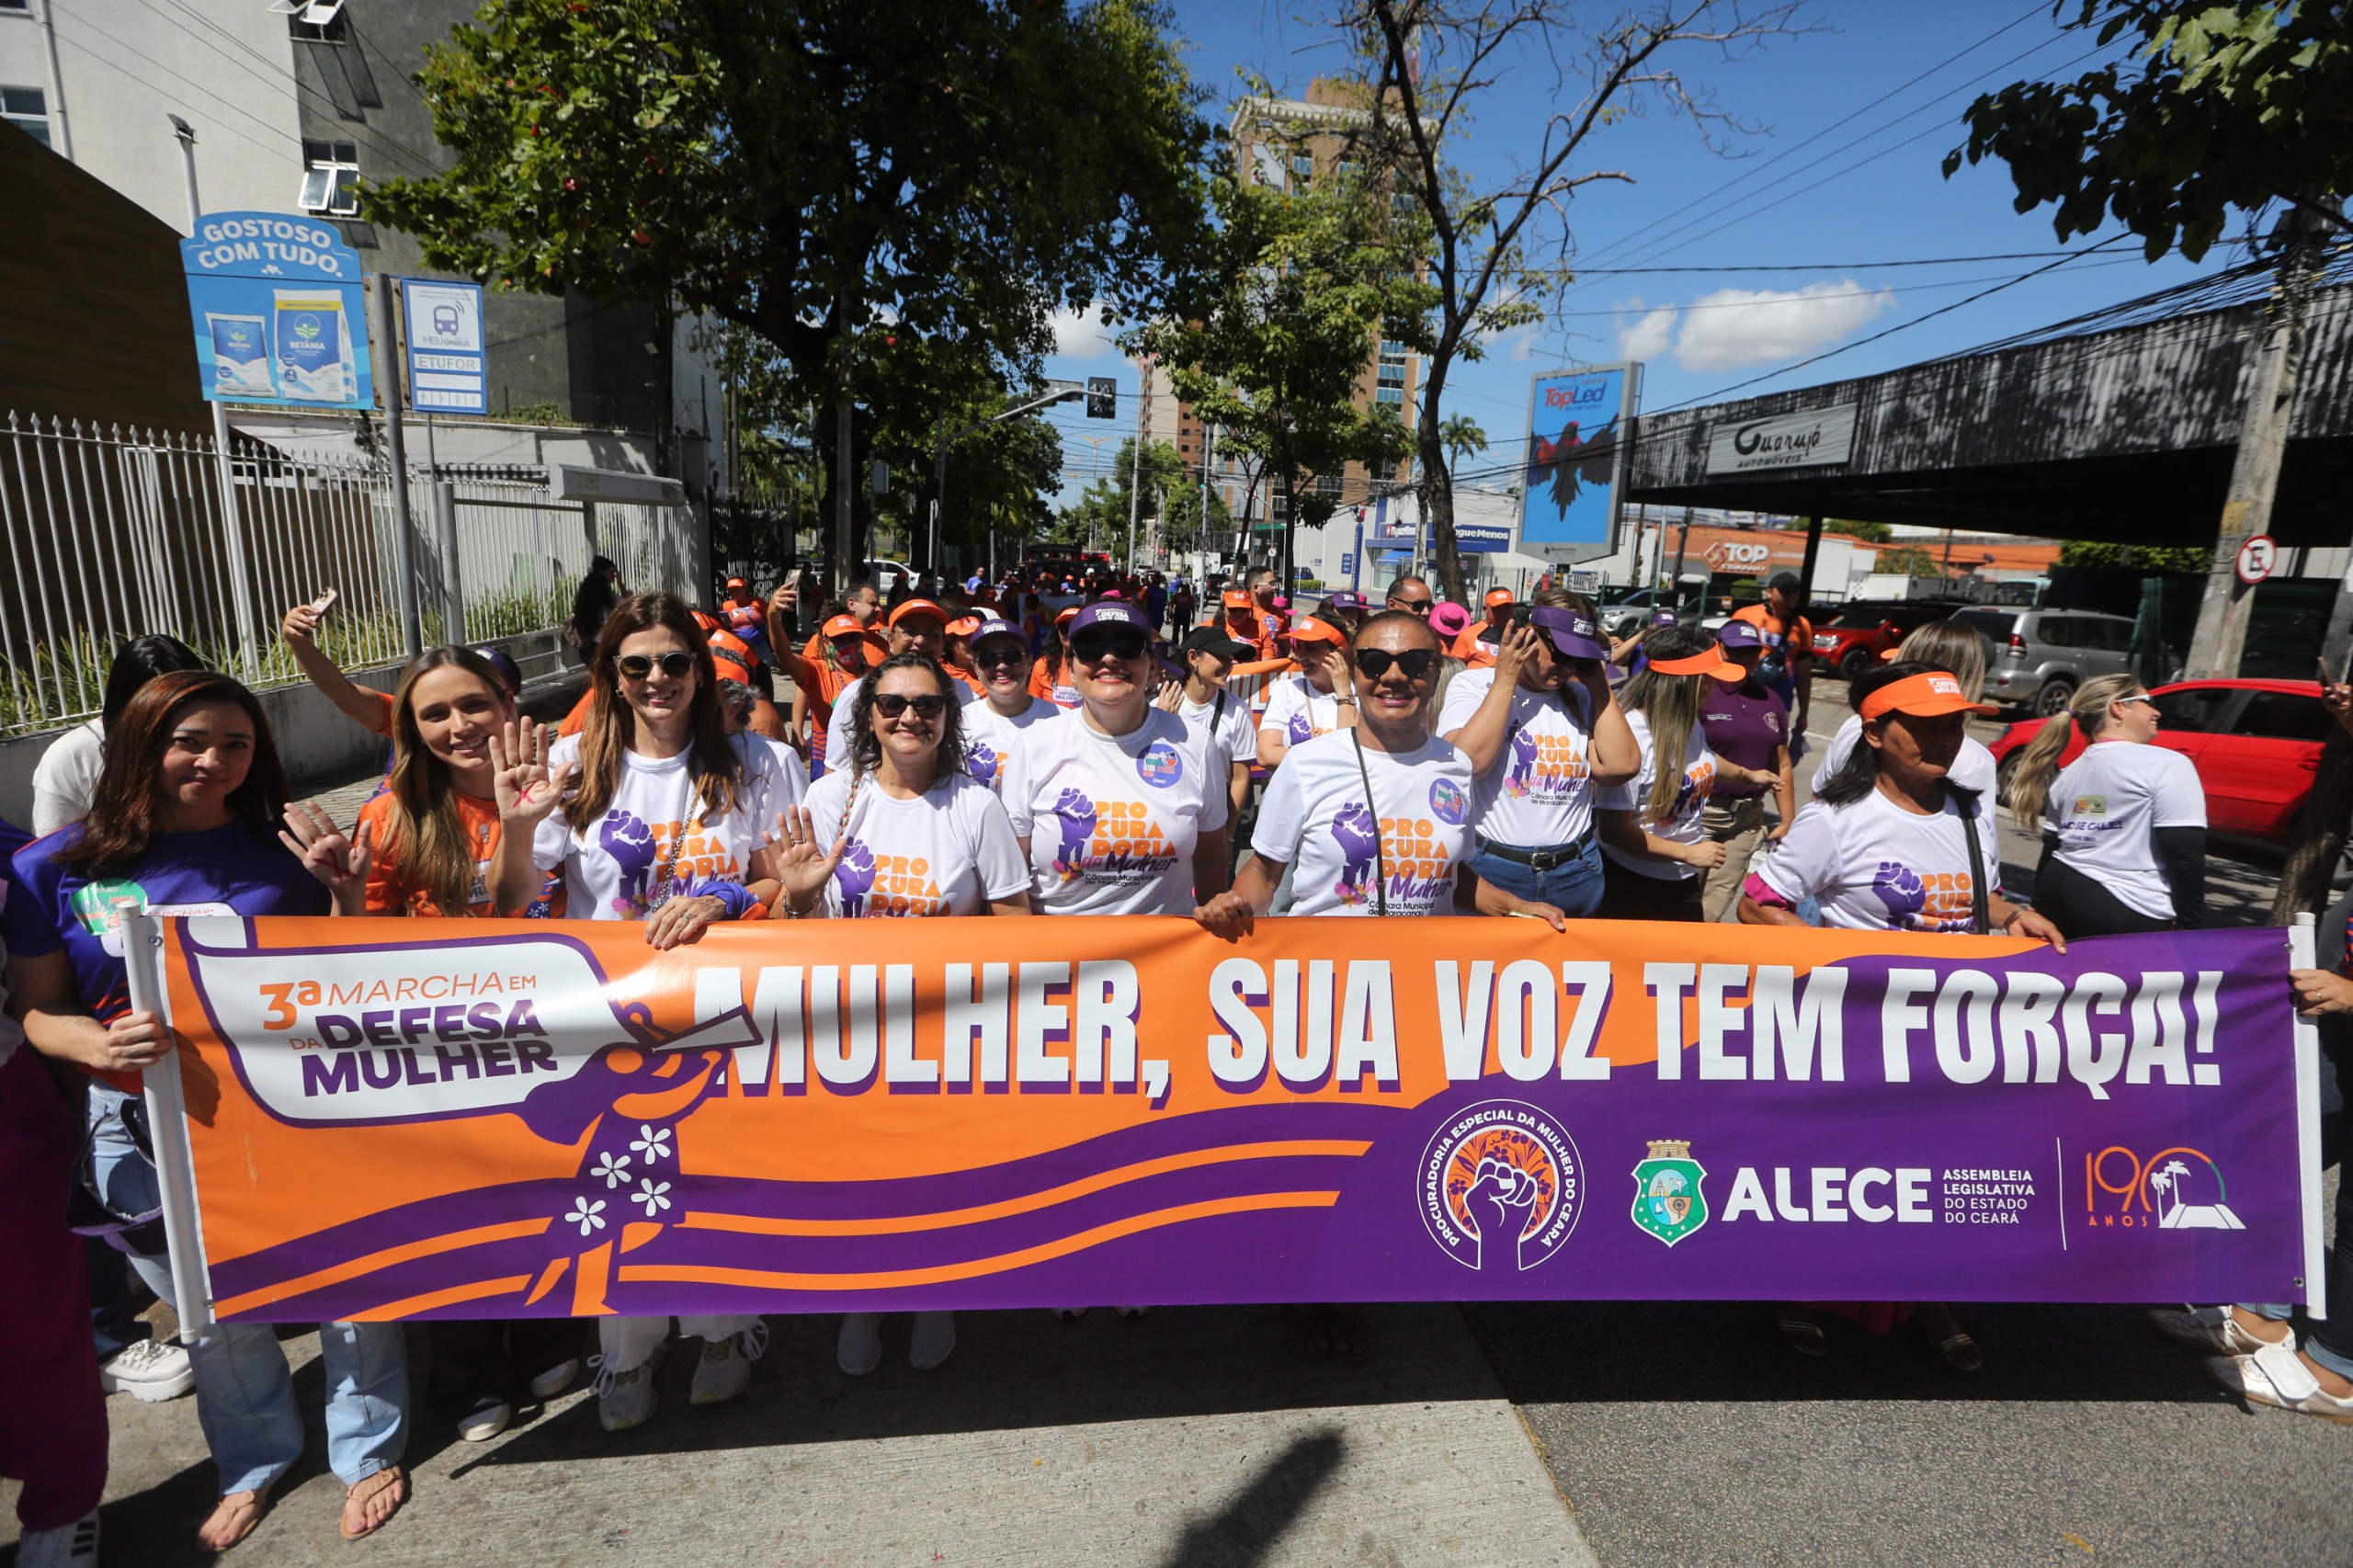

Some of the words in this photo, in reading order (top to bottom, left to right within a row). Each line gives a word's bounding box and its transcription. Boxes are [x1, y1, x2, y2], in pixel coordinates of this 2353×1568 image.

[204, 219, 331, 249] GOSTOSO
[198, 242, 260, 268] COM
[262, 242, 343, 278] TUDO.
[289, 339, 326, 350] BETÂNIA
[419, 357, 475, 370] ETUFOR
[1734, 419, 1822, 457] Guarujá
[1737, 453, 1803, 468] AUTOMÓVEIS
[1724, 542, 1768, 562] TOP
[1534, 734, 1570, 748] PRO
[1537, 749, 1582, 763] CURA
[1537, 763, 1587, 778] DORIA
[1096, 801, 1147, 819] PRO
[1094, 820, 1165, 838] CURA
[1380, 817, 1434, 838] PRO
[1092, 838, 1176, 857] DORIA
[1381, 838, 1449, 859] CURA
[875, 854, 929, 877] PRO
[1081, 856, 1103, 869] da
[1105, 849, 1179, 873] Mulher
[1381, 859, 1453, 880] DORIA
[871, 874, 941, 898] CURA
[1390, 870, 1453, 902] Mulher
[1921, 872, 1972, 892] PRO
[870, 893, 951, 916] DORIA
[1403, 902, 1435, 910] Municipal
[1923, 892, 1974, 911] CUR
[327, 971, 504, 1006] MARCHA
[509, 974, 537, 991] EM
[290, 1037, 323, 1051] DA
[314, 998, 551, 1050] DEFESA
[692, 959, 1169, 1099] MULHER,
[1207, 957, 1401, 1085] SUA
[1434, 960, 1611, 1082] VOZ
[1643, 961, 1845, 1083] TEM
[1883, 968, 2224, 1100] FORÇA!
[301, 1040, 558, 1097] MULHER
[1427, 1136, 1461, 1247] PROCURADORIA
[1449, 1109, 1515, 1140] ESPECIAL
[1517, 1111, 1536, 1129] DA
[1536, 1121, 1574, 1176] MULHER
[1564, 1178, 1576, 1200] DO
[1942, 1168, 2033, 1182] ASSEMBLEIA
[1721, 1166, 1934, 1223] ALECE
[1943, 1183, 2036, 1196] LEGISLATIVA
[1944, 1198, 1966, 1210] DO
[1970, 1198, 2028, 1210] ESTADO
[1945, 1211, 1967, 1223] DO
[1970, 1209, 2020, 1224] CEARÁ
[2088, 1215, 2149, 1228] ANOS
